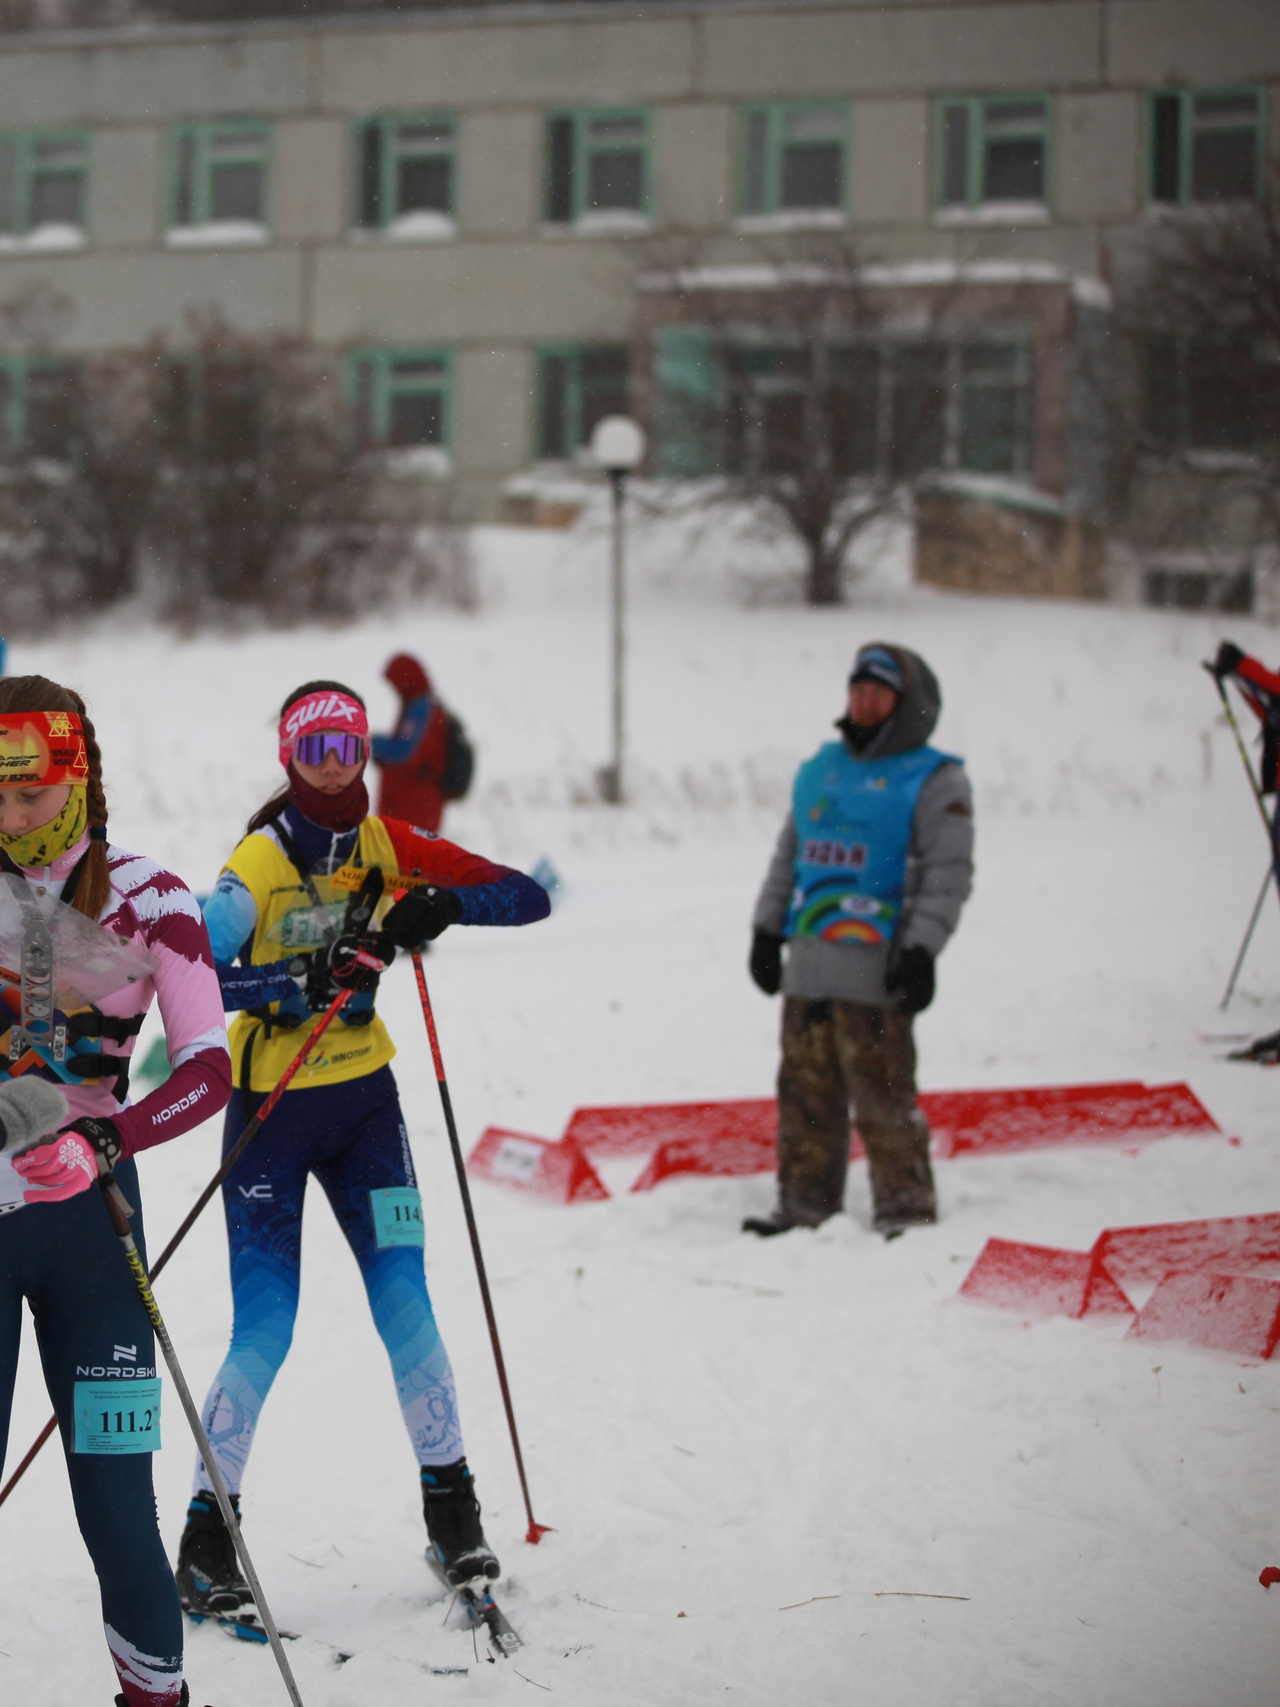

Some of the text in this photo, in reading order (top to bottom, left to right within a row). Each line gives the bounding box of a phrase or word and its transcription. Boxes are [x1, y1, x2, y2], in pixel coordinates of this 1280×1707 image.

[151, 1082, 209, 1126] NORDSKI
[76, 1365, 156, 1378] NORDSKI
[100, 1409, 152, 1434] 111.2
